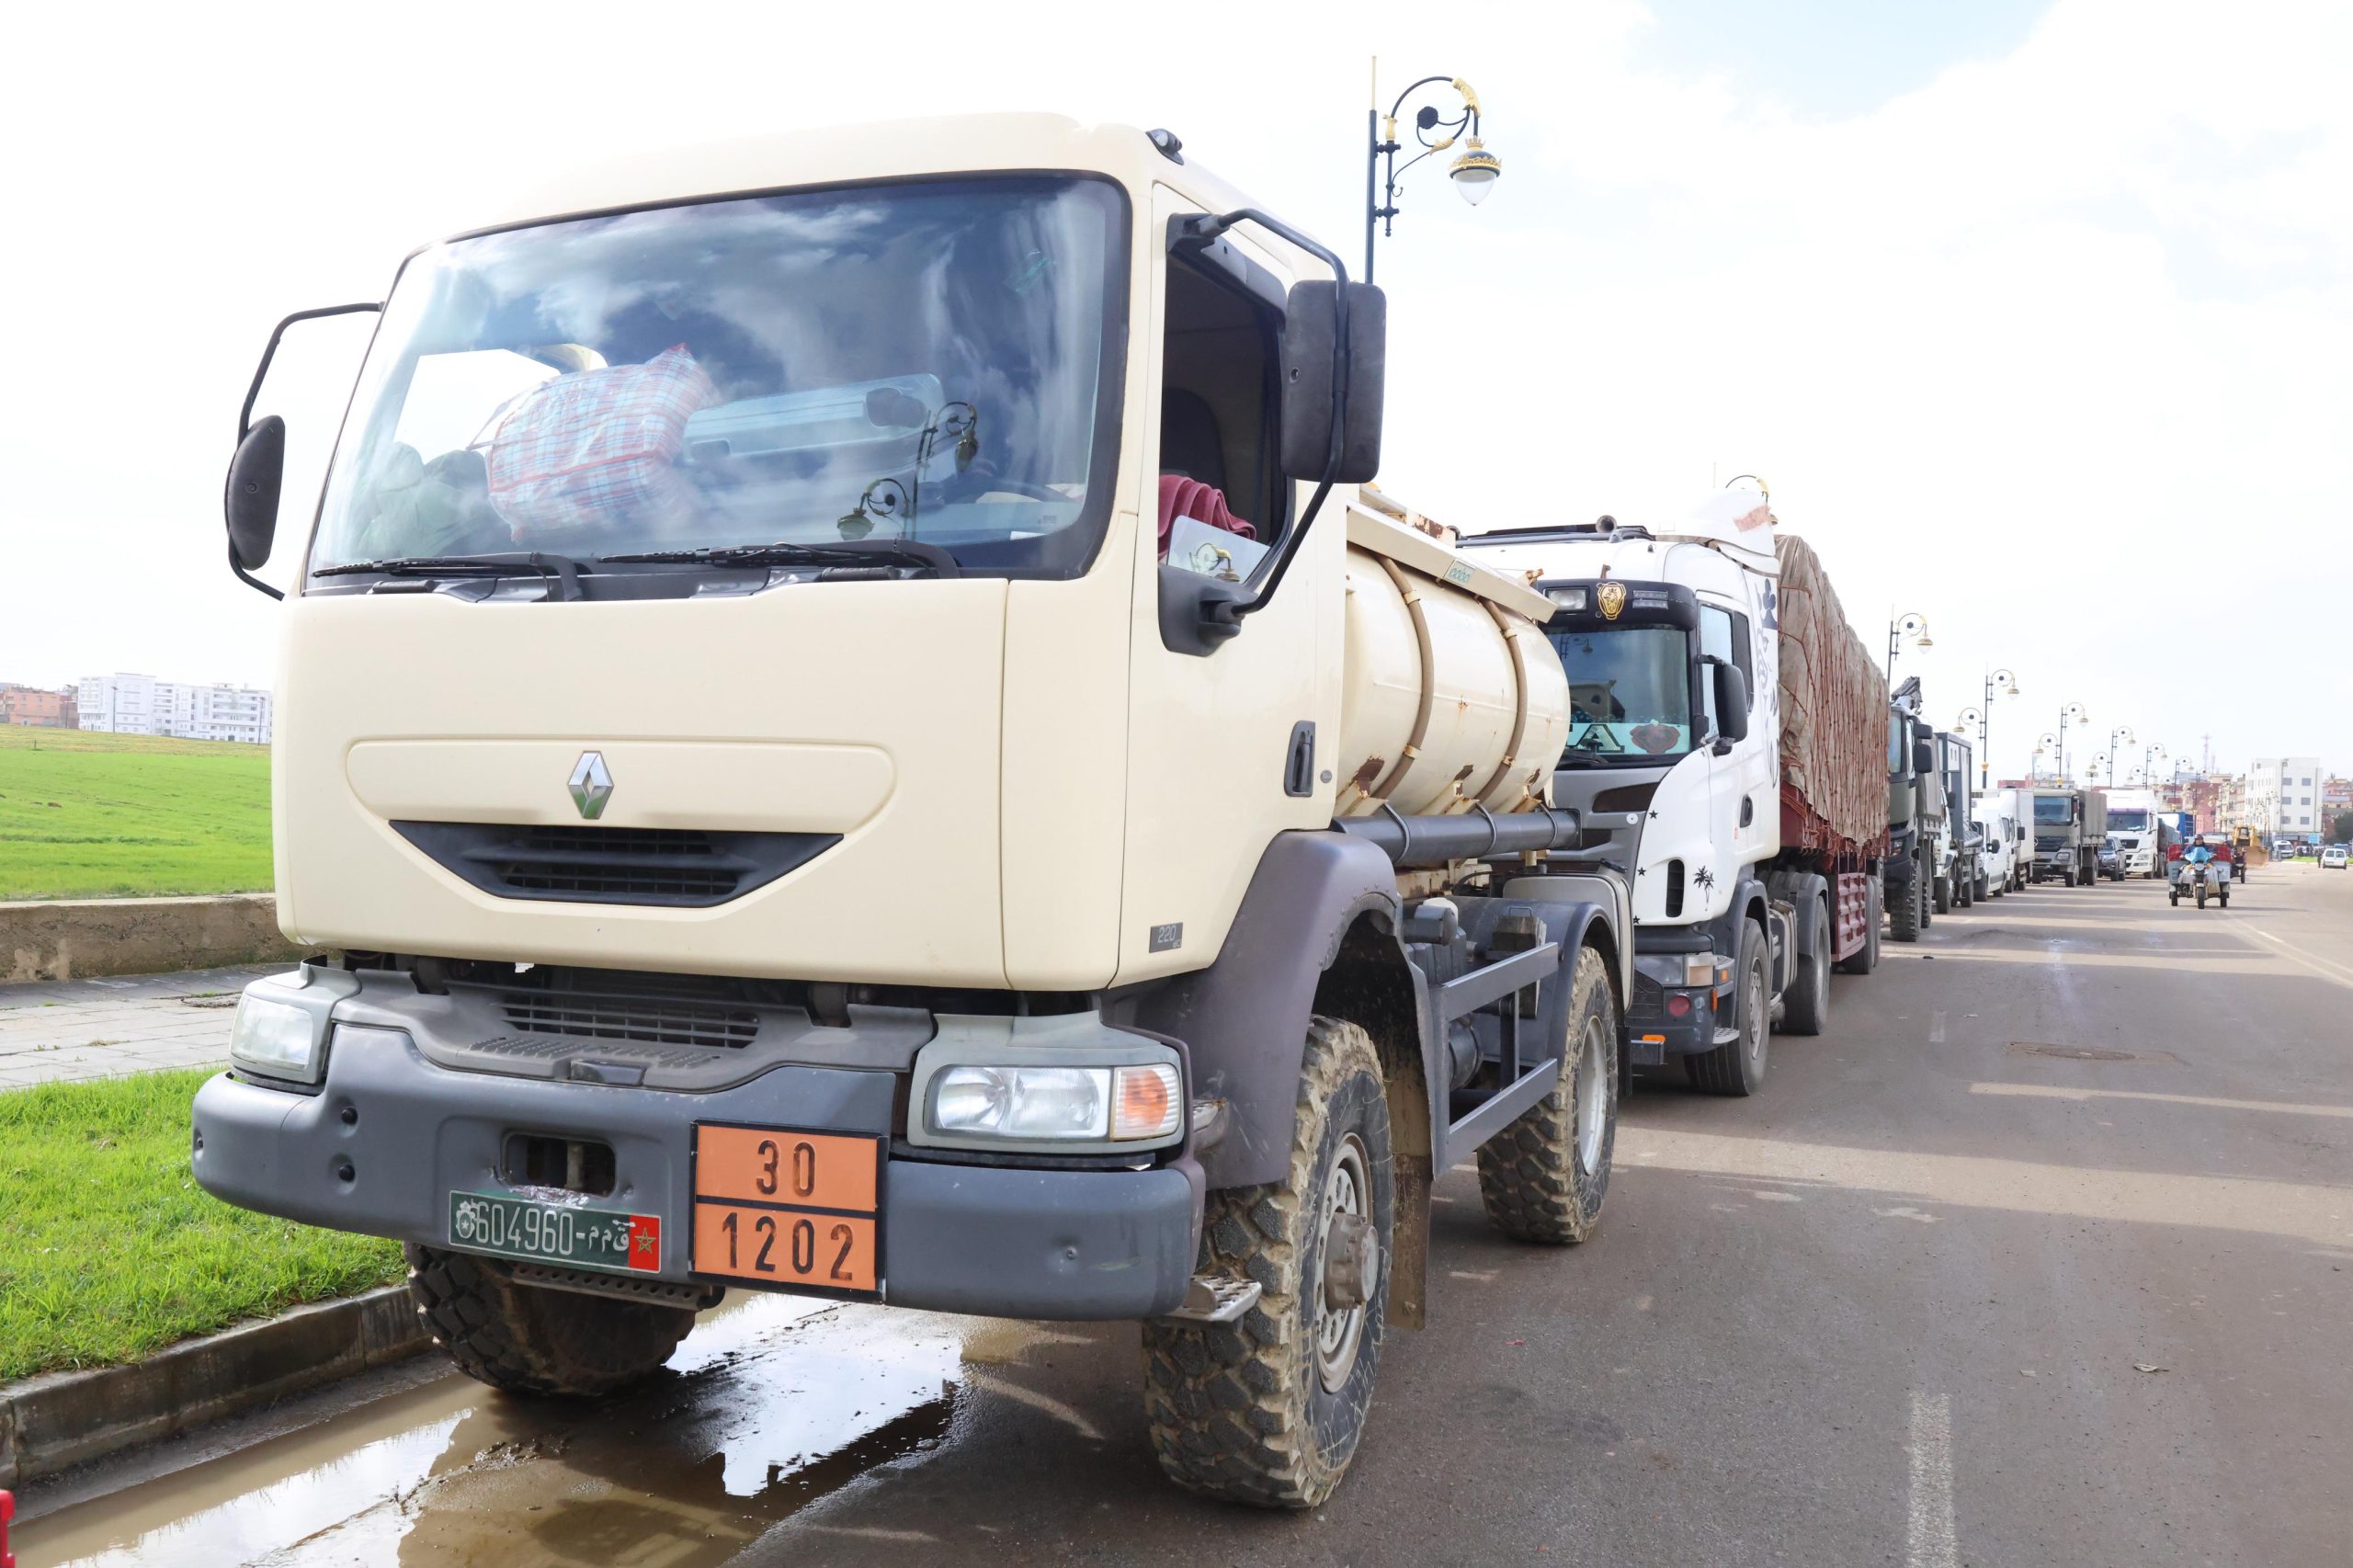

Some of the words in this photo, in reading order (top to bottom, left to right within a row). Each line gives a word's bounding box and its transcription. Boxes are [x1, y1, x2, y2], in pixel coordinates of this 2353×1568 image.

[1158, 925, 1176, 943] 220
[756, 1140, 816, 1198] 30
[722, 1211, 853, 1281] 1202
